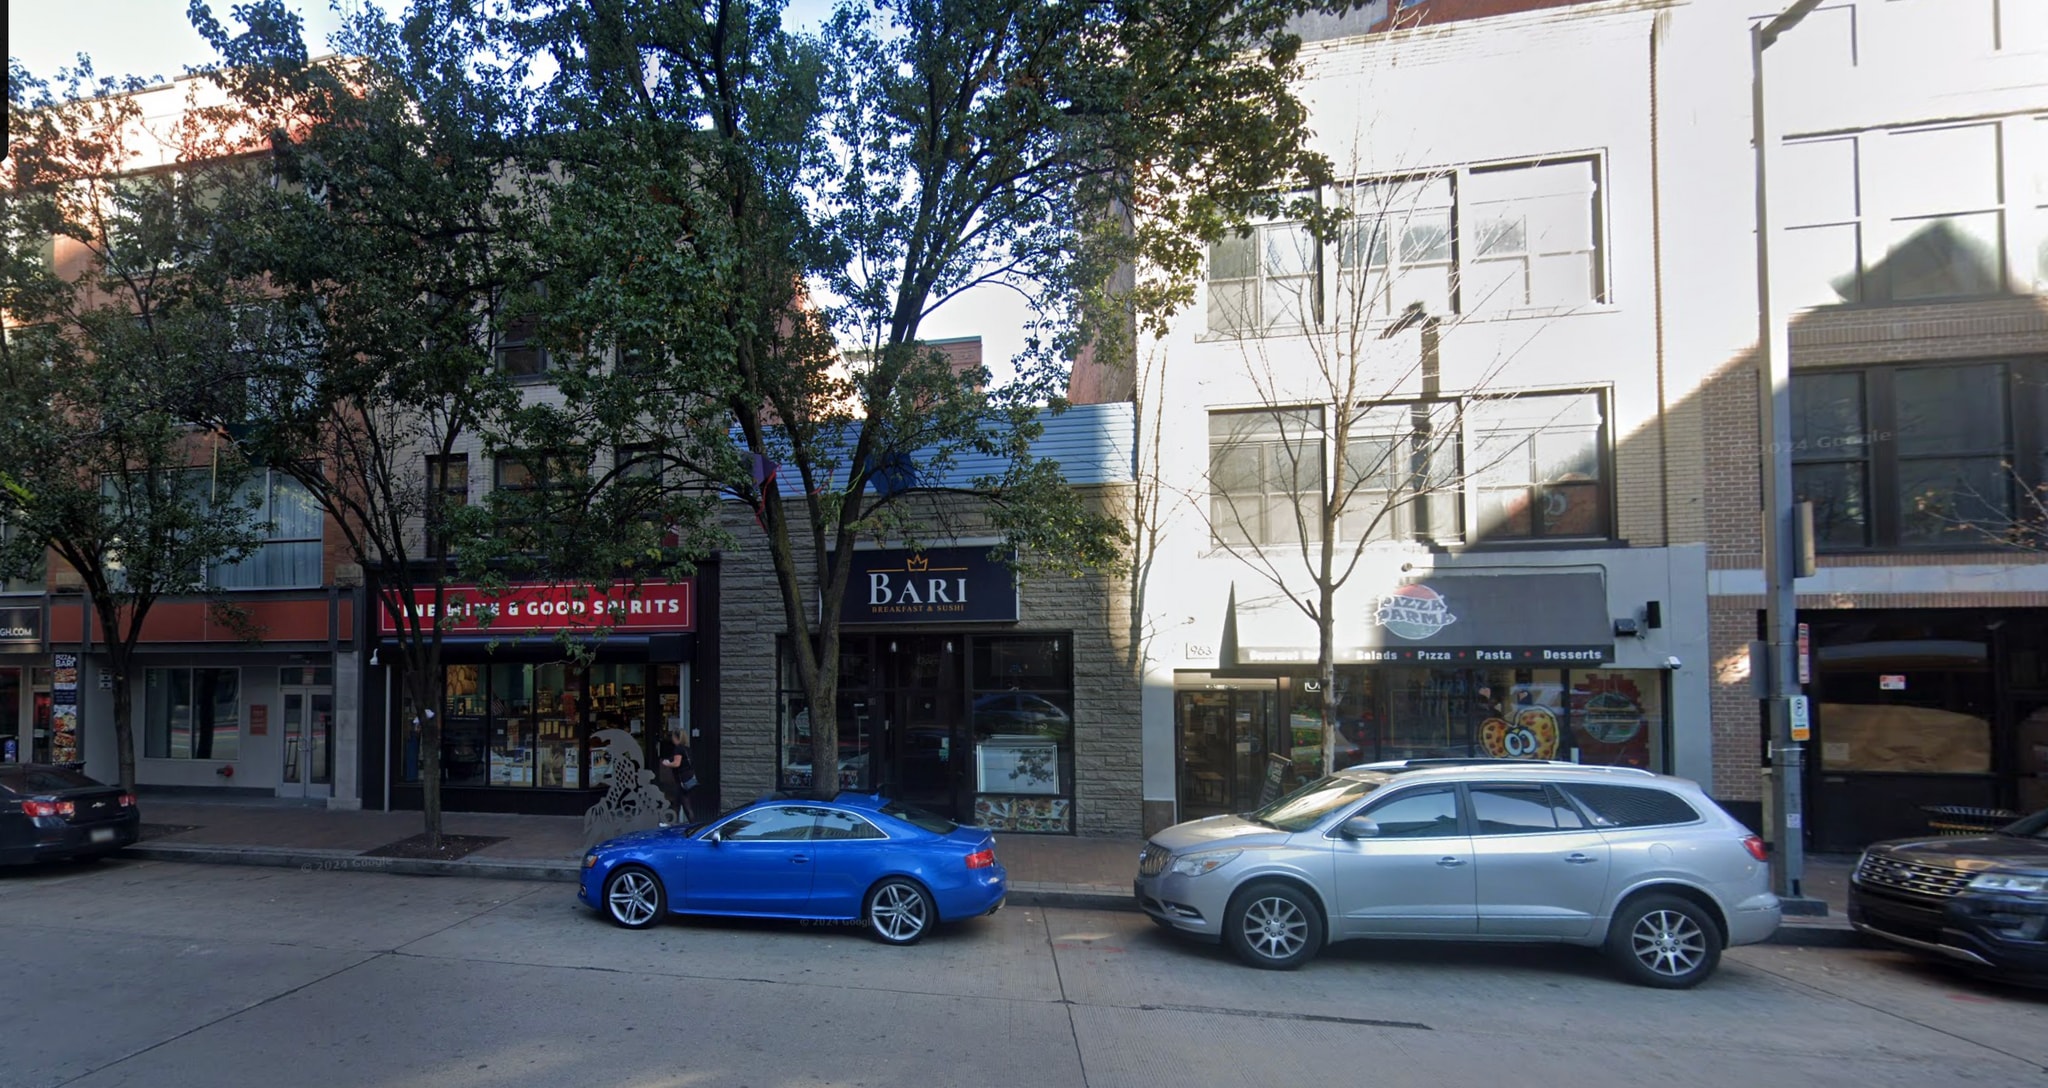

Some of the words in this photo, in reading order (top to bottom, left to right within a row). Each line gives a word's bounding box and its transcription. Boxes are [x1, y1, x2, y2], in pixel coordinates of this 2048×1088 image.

[508, 601, 519, 616] &
[527, 601, 585, 615] GOOD
[872, 605, 923, 613] BREAKFAST
[937, 603, 965, 612] SUSHI
[1379, 595, 1446, 612] PIZZA
[1190, 645, 1212, 656] 963
[1356, 650, 1398, 660] Salads
[1417, 651, 1451, 660] Pizza
[1476, 650, 1512, 660] Pasta
[1543, 650, 1602, 660] Desserts
